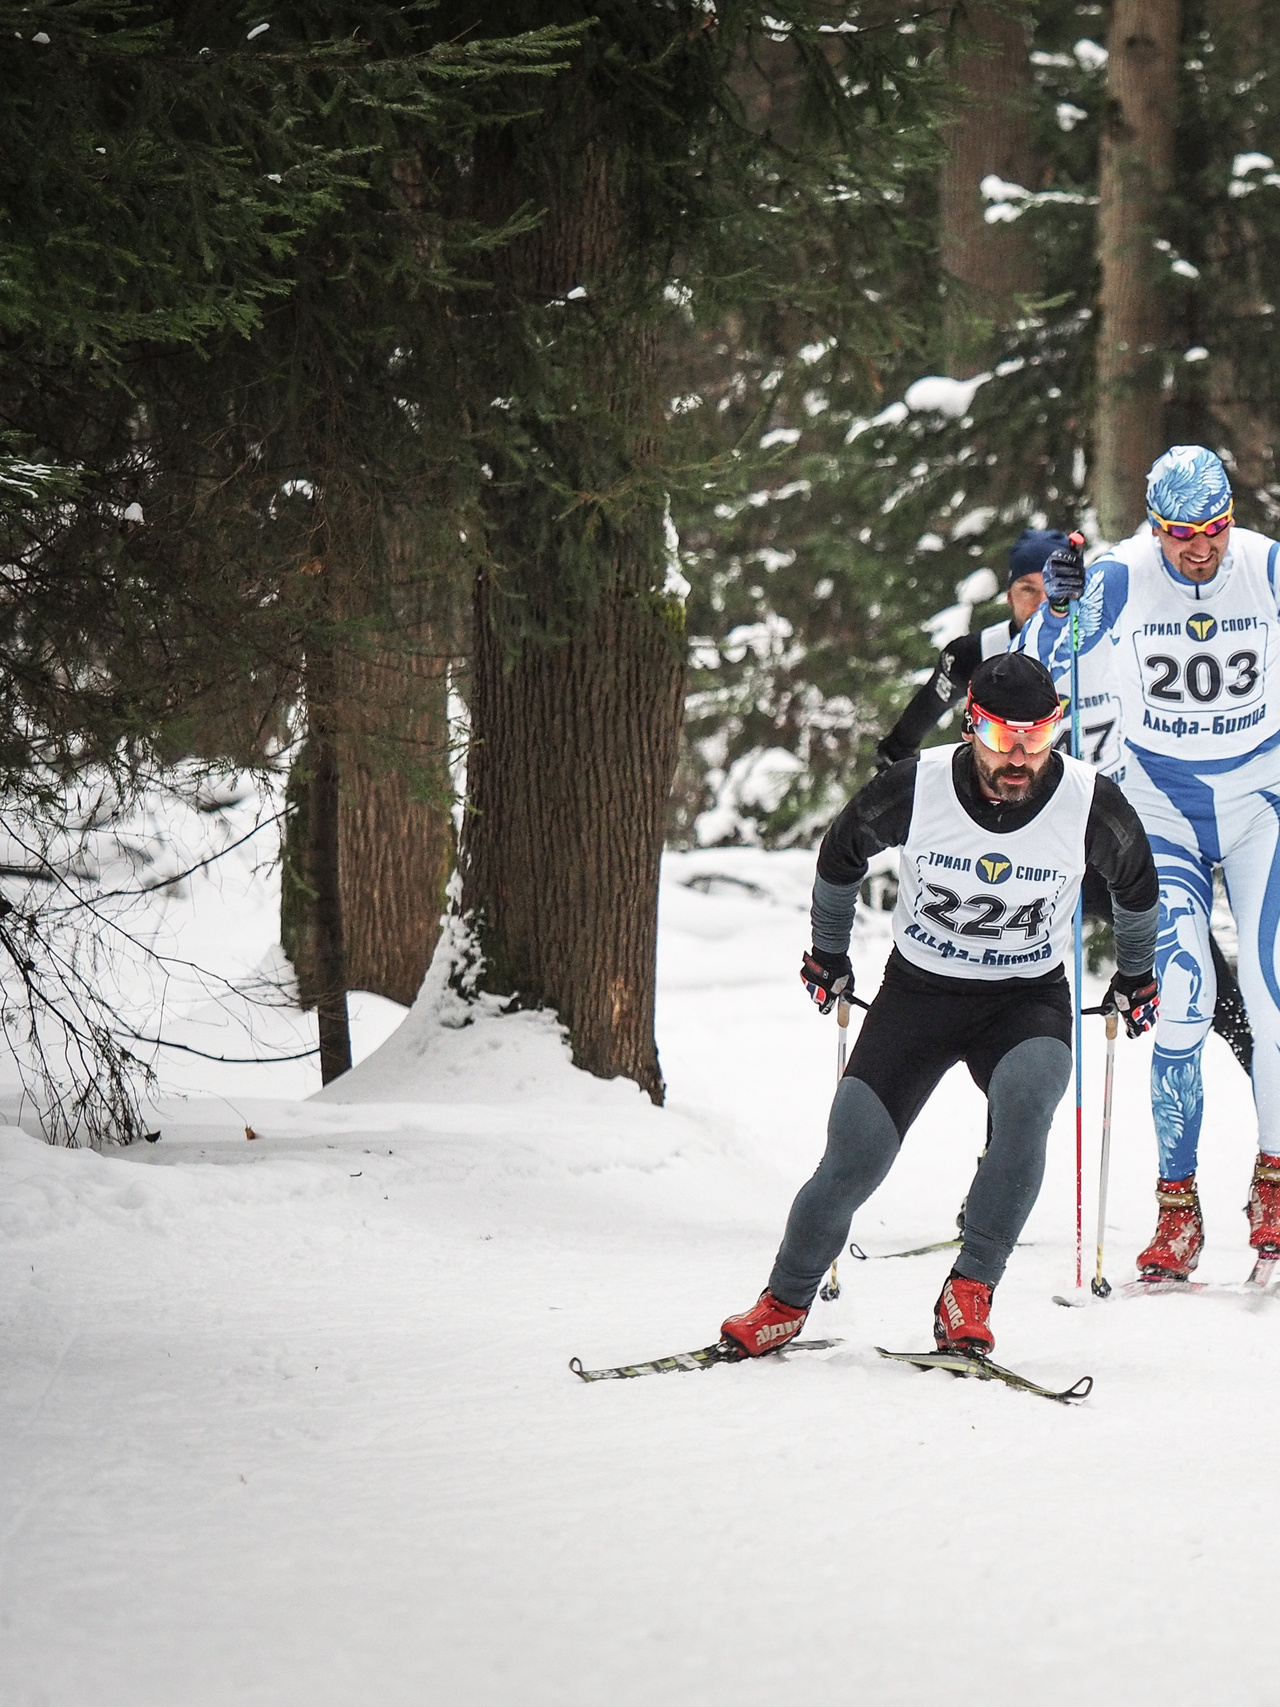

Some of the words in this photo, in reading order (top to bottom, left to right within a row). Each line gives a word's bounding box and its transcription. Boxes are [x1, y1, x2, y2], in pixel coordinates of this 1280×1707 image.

[1143, 622, 1182, 636] ТРИАЛ
[1221, 616, 1258, 633] СПОРТ
[1144, 649, 1260, 704] 203
[1143, 703, 1267, 738] Альфа-Битца
[928, 851, 972, 872] ТРИАЛ
[1015, 865, 1060, 882] СПОРТ
[920, 883, 1048, 941] 224
